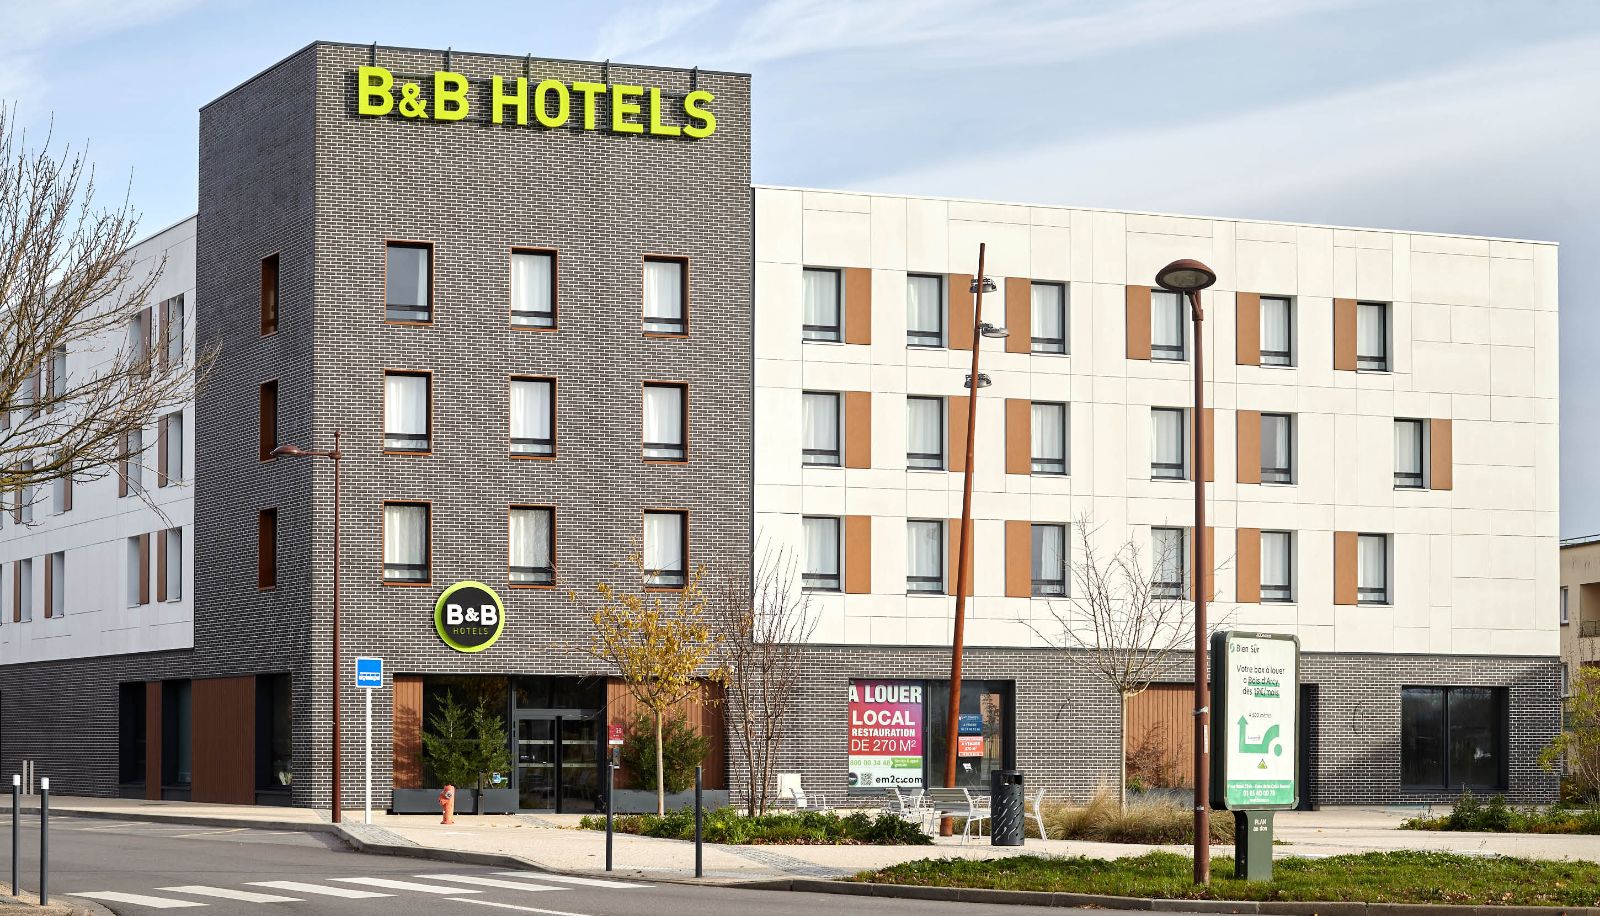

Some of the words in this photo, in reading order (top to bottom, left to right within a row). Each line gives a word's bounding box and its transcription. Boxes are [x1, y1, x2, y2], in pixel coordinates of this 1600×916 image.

[358, 66, 469, 121] B&B
[492, 75, 717, 138] HOTELS
[446, 604, 498, 625] B&B
[453, 627, 489, 635] HOTELS
[1236, 664, 1253, 673] Votre
[1271, 666, 1286, 675] louer
[1248, 676, 1261, 685] Bois
[864, 684, 922, 703] LOUER
[1243, 686, 1253, 696] dès
[852, 709, 916, 726] LOCAL
[851, 728, 916, 737] RESTAURATION
[851, 739, 870, 752] DE
[873, 739, 897, 752] 270
